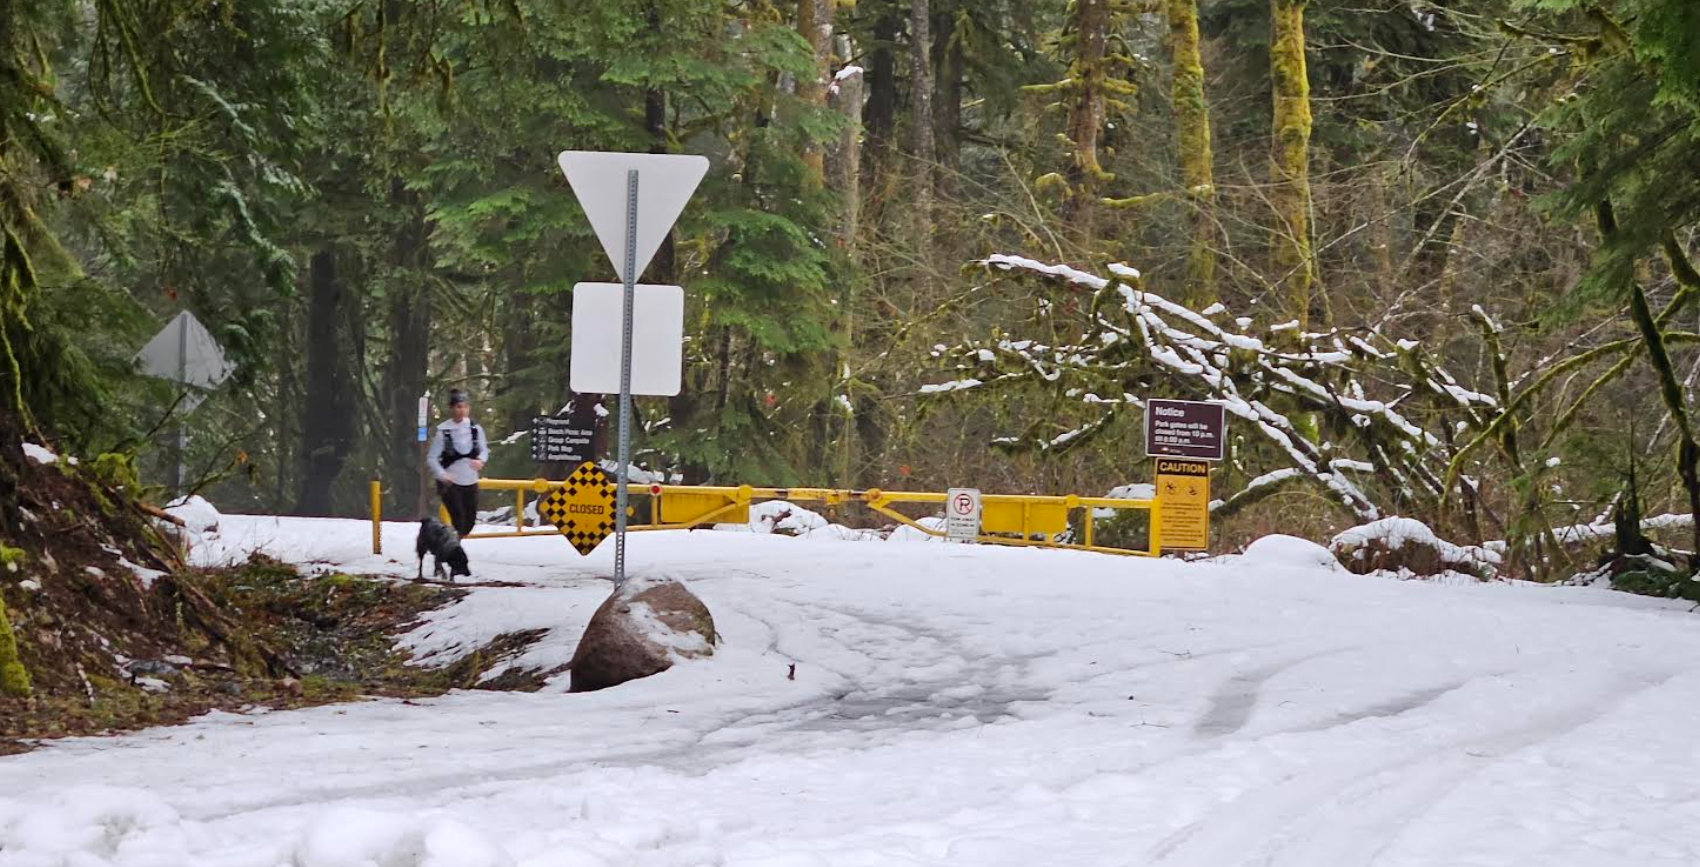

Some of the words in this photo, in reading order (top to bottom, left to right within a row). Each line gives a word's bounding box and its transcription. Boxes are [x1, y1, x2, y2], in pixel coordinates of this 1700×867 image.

[1155, 406, 1185, 417] Notice
[1155, 420, 1169, 428] Park
[548, 436, 564, 444] Group
[565, 437, 590, 445] Campsite
[560, 445, 573, 453] Map
[1159, 462, 1206, 474] CAUTION
[569, 503, 604, 515] CLOSED
